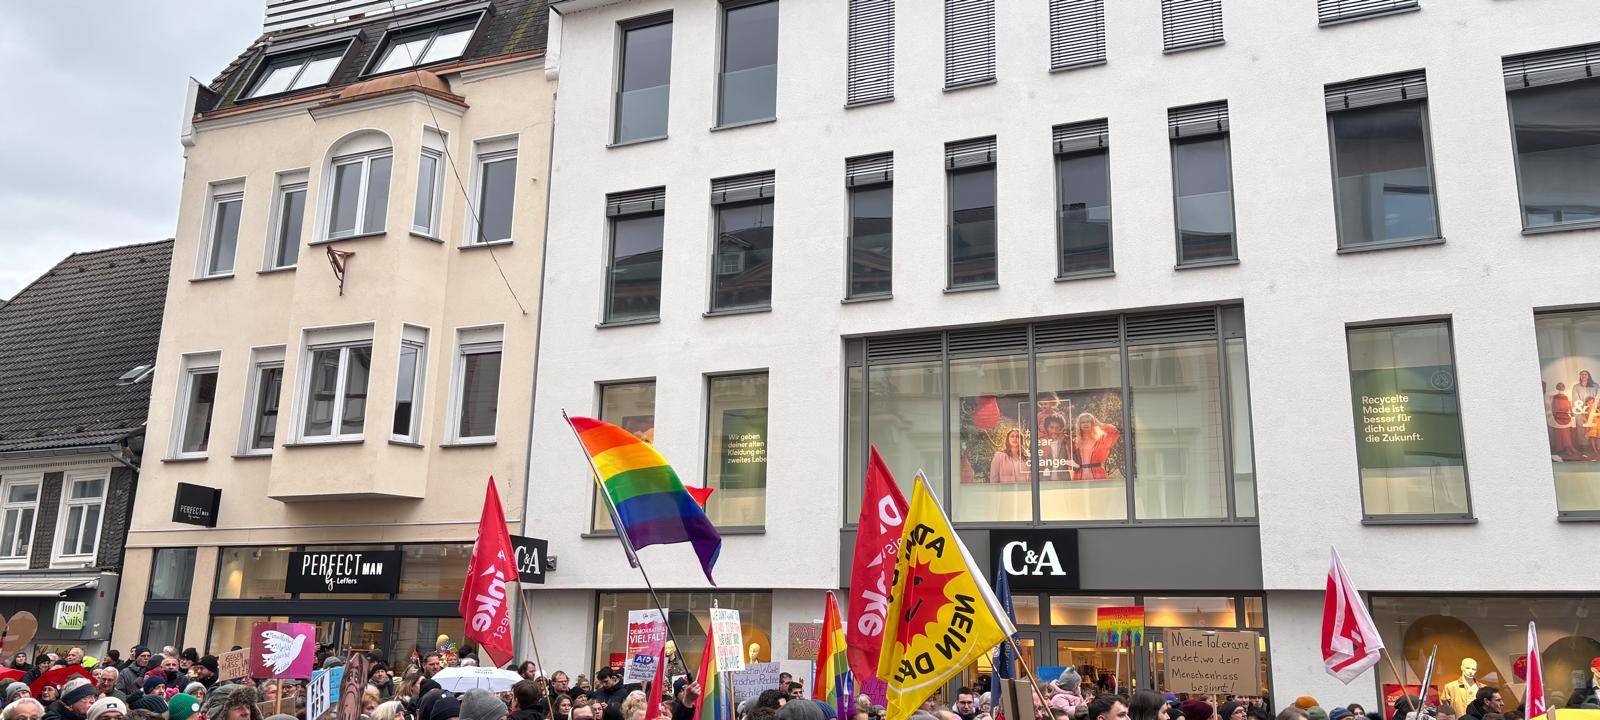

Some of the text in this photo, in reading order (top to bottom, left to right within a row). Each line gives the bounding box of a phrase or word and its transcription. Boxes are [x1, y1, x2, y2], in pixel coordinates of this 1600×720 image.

[1361, 395, 1409, 405] Recycelte
[1363, 404, 1404, 414] Mode ist
[1363, 414, 1411, 424] besser für
[1364, 424, 1405, 433] dich und
[740, 433, 760, 441] geben
[1365, 433, 1424, 443] die Zukunft.
[1026, 458, 1066, 468] cange
[180, 504, 202, 515] PERFECT
[515, 545, 541, 575] C&A
[1002, 540, 1066, 576] C&A
[301, 554, 383, 576] PERFECT MAN
[59, 615, 82, 626] Nails
[629, 632, 665, 644] VIELFALT
[1171, 631, 1202, 647] Meine
[1219, 654, 1240, 664] dein
[221, 660, 239, 671] HASS
[1171, 668, 1239, 681] Menschenhass
